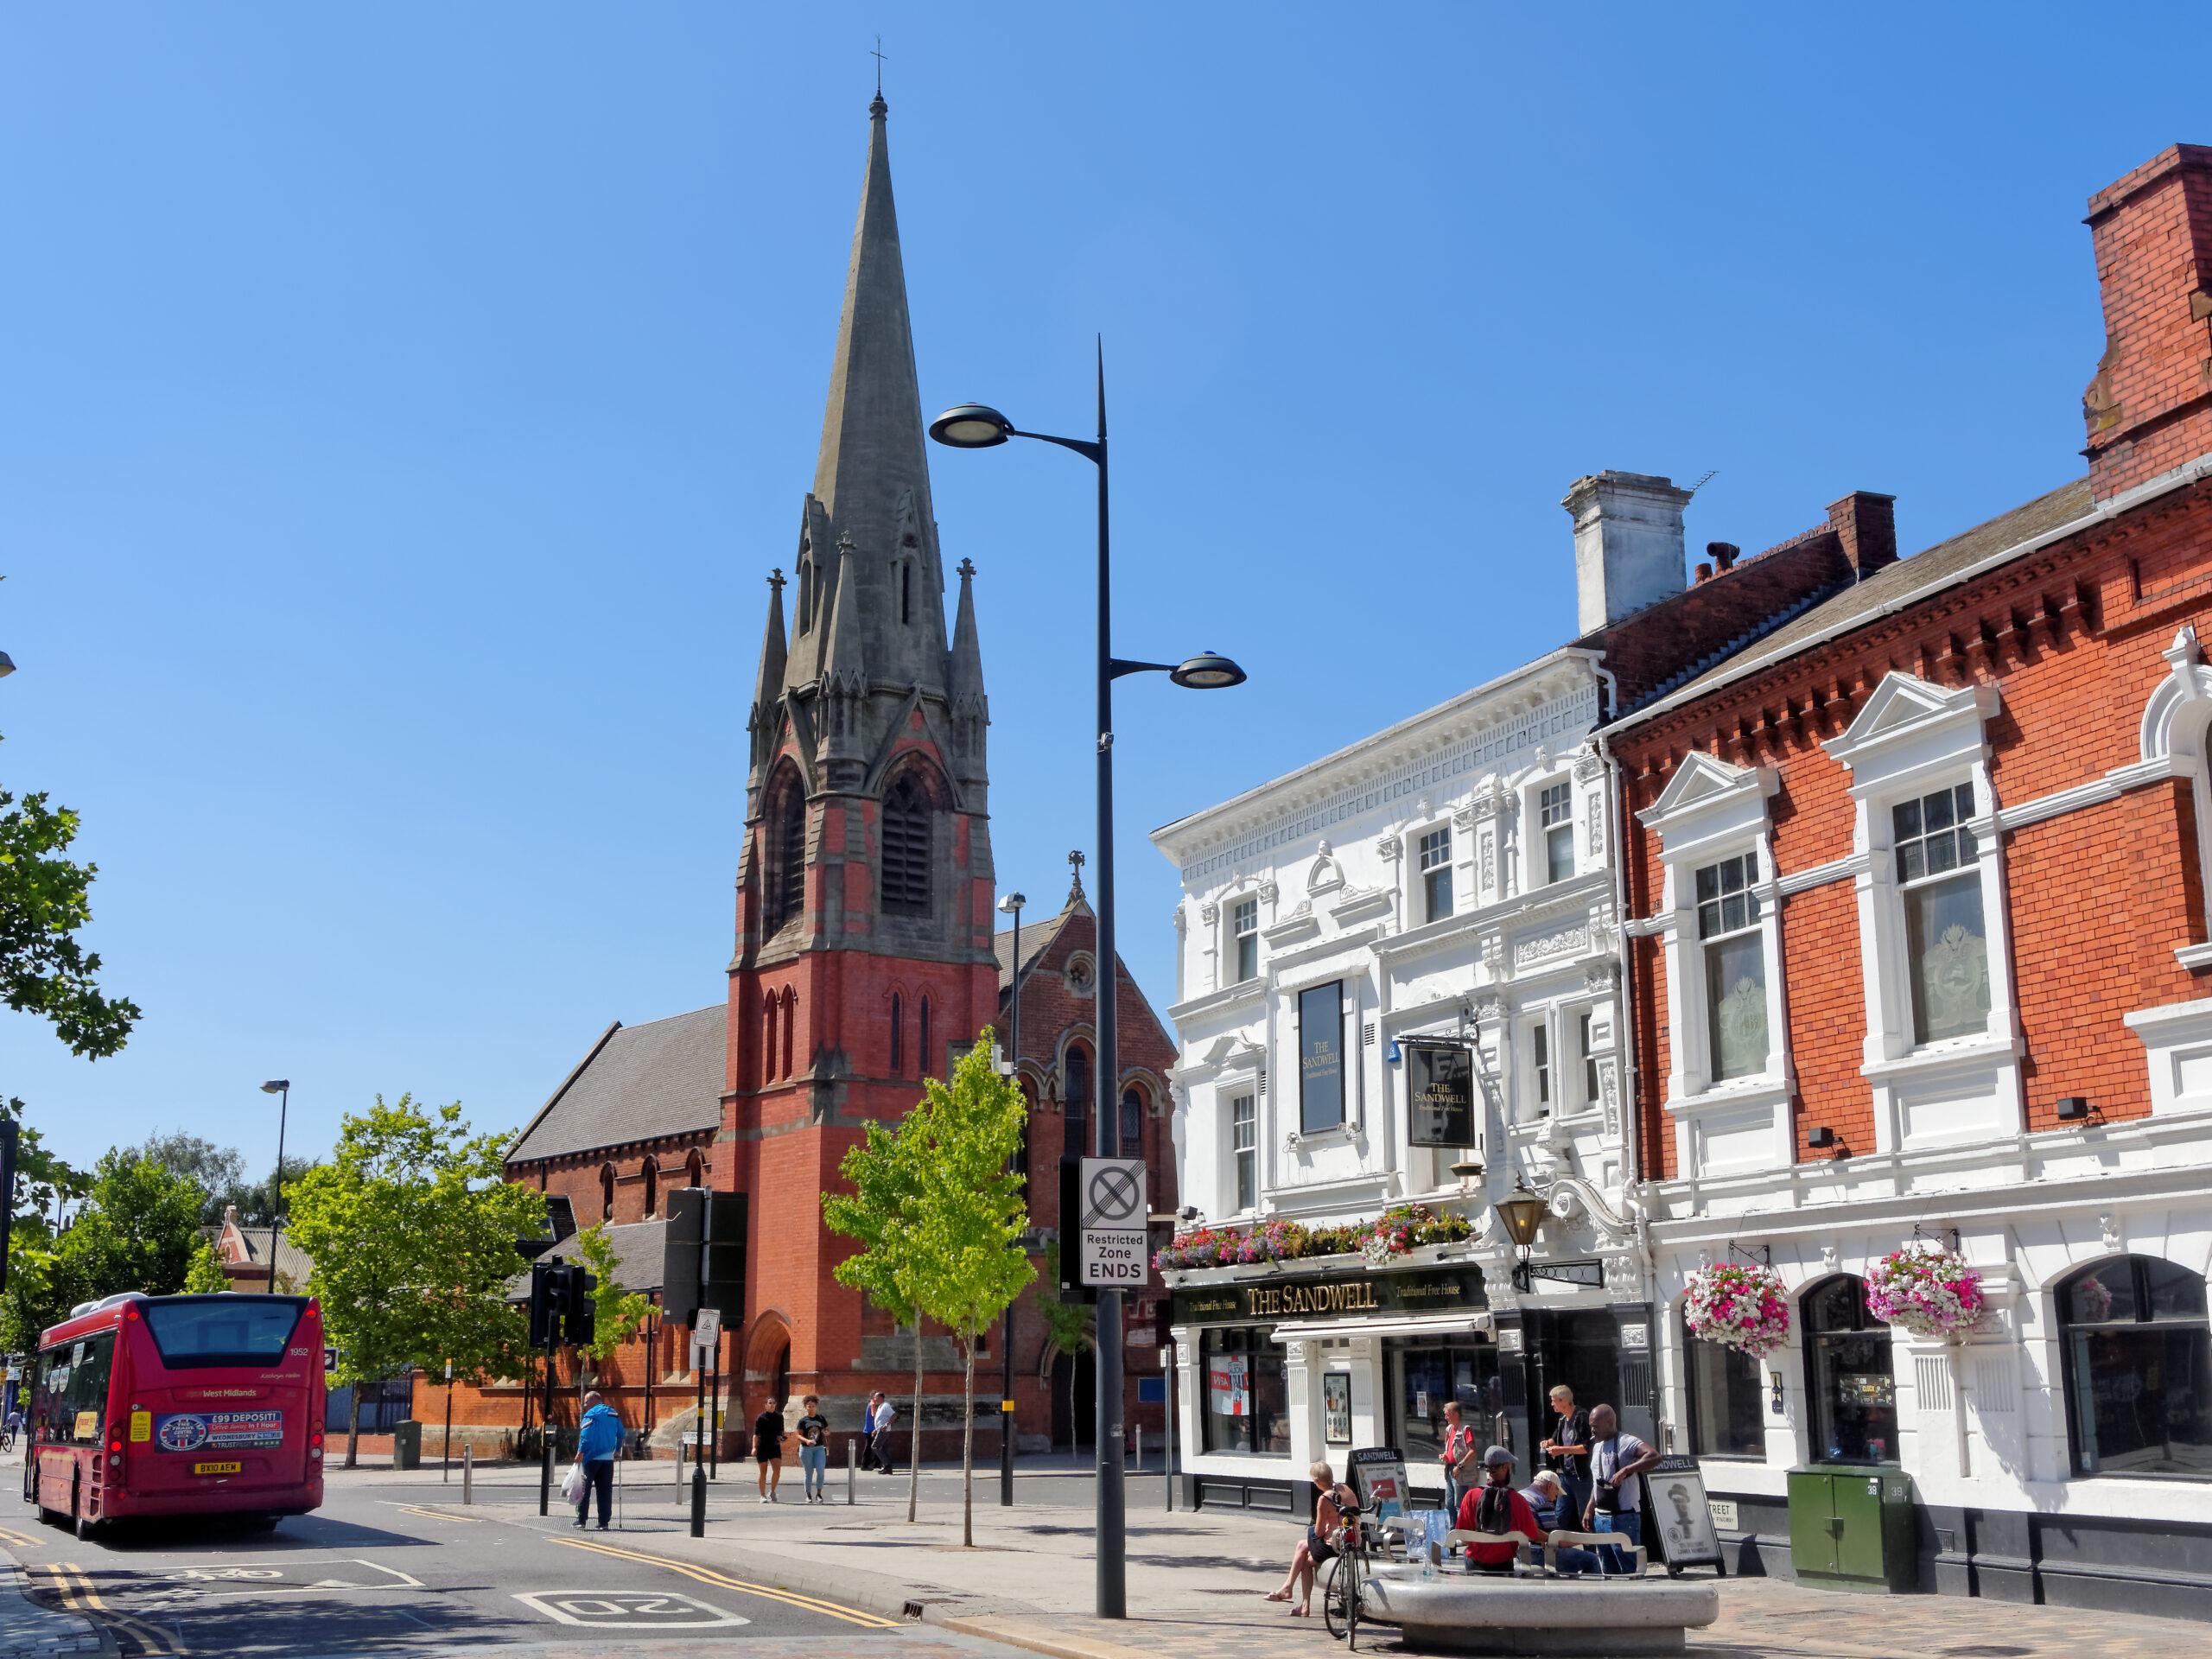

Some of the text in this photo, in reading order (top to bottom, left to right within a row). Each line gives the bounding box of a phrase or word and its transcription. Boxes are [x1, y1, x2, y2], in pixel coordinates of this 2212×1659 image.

[1314, 1041, 1328, 1053] THE
[1302, 1052, 1340, 1070] SANDWELL
[1430, 1083, 1451, 1093] THE
[1414, 1092, 1466, 1104] SANDWELL
[1087, 1234, 1143, 1245] Restricted
[1098, 1247, 1132, 1259] Zone
[1090, 1262, 1141, 1279] ENDS
[1395, 1283, 1460, 1297] Traditional Free House
[1247, 1282, 1379, 1315] THE SANDWELL
[223, 1389, 257, 1397] Midlands
[212, 1413, 276, 1423] £99 DEPOSIT!
[1357, 1451, 1398, 1462] SANDWELL
[200, 1464, 219, 1472] BX10
[1867, 1484, 1877, 1496] 39
[1891, 1486, 1903, 1497] 39
[1708, 1503, 1730, 1515] TREET
